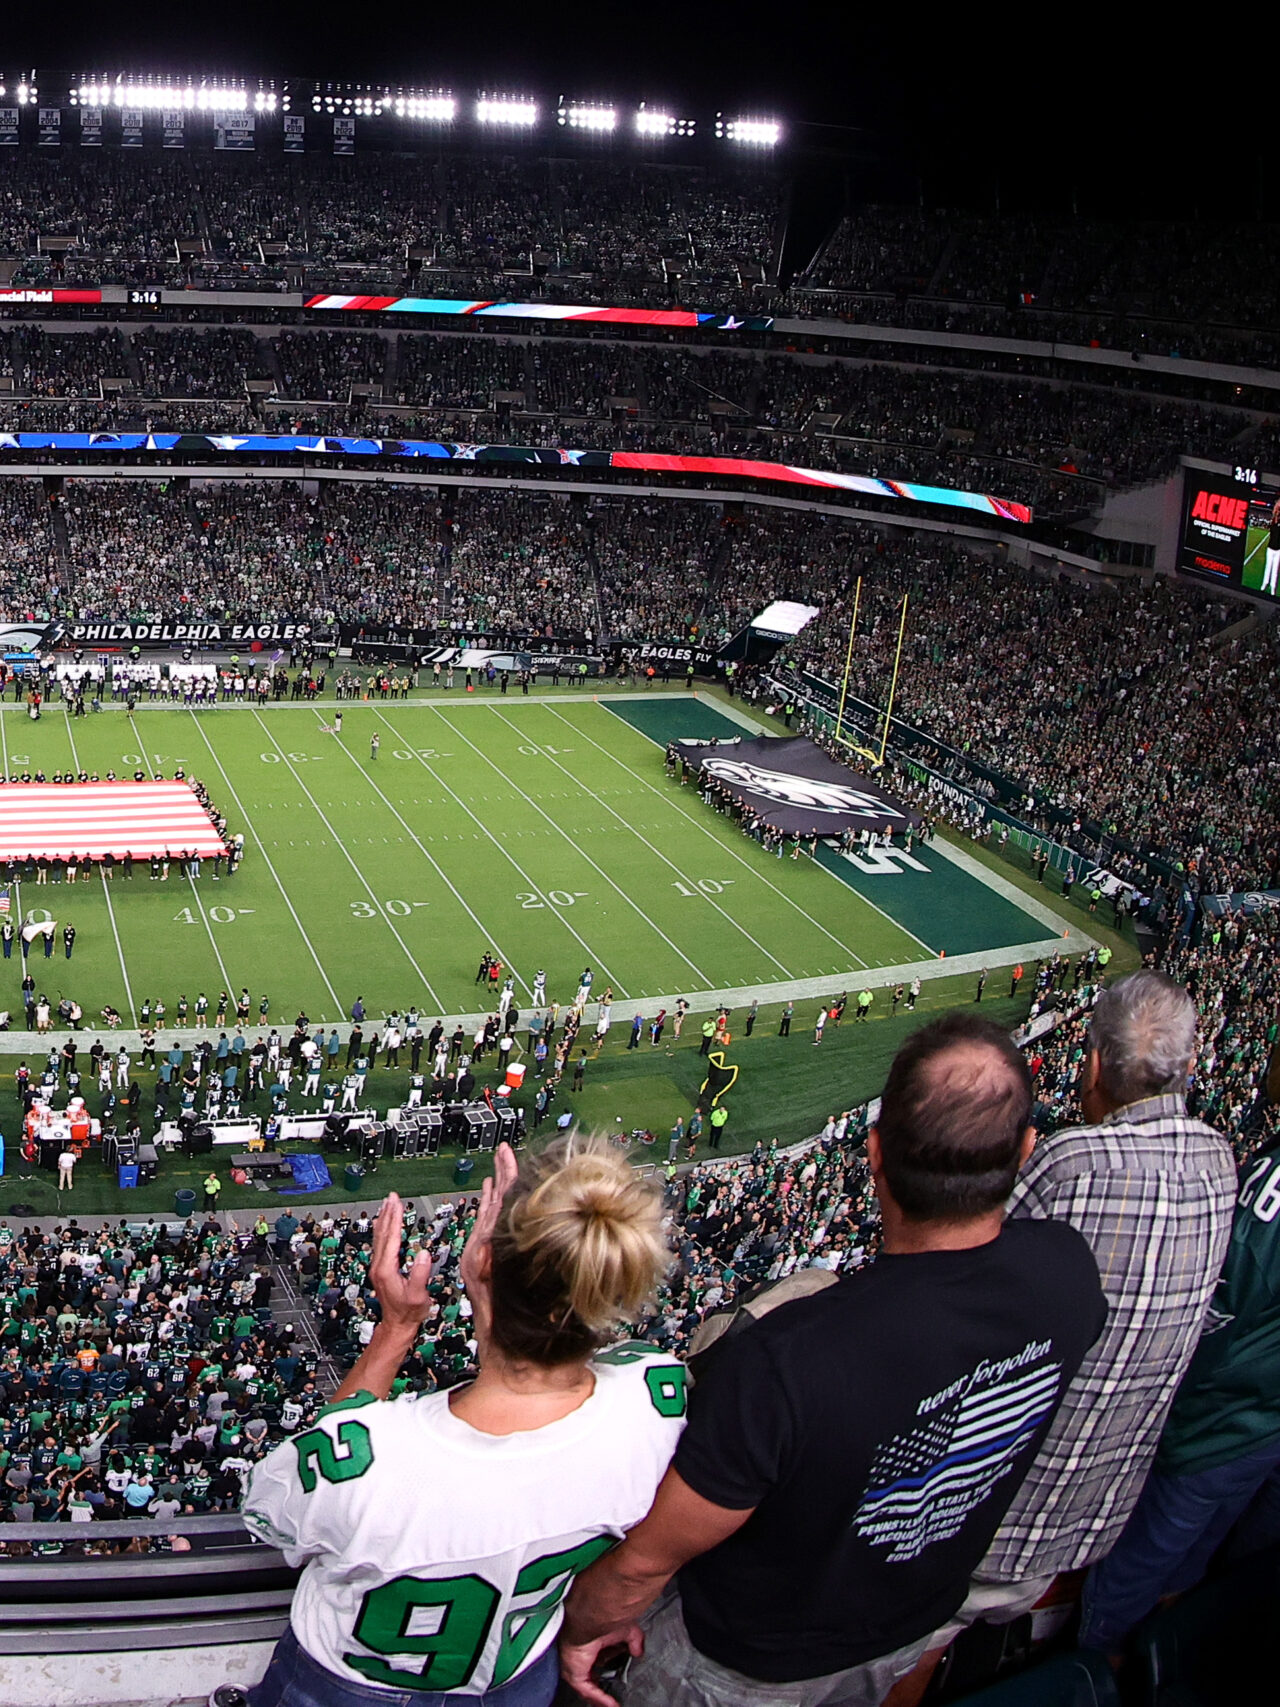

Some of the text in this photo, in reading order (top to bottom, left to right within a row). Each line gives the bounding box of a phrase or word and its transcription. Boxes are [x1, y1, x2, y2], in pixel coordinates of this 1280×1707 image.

[231, 120, 248, 128] 2017
[26, 290, 52, 302] Field
[132, 292, 157, 303] 3:16
[1235, 466, 1257, 484] 3:16
[73, 624, 307, 640] PHILADELPHIA EAGLES
[640, 646, 691, 660] EAGLES
[696, 652, 712, 662] FLY
[671, 878, 724, 897] 10
[350, 899, 412, 918] 30
[515, 890, 575, 910] 20
[173, 905, 236, 924] 40
[916, 1338, 1053, 1416] never forgotten
[934, 1490, 971, 1509] STATE
[342, 1534, 624, 1691] 92
